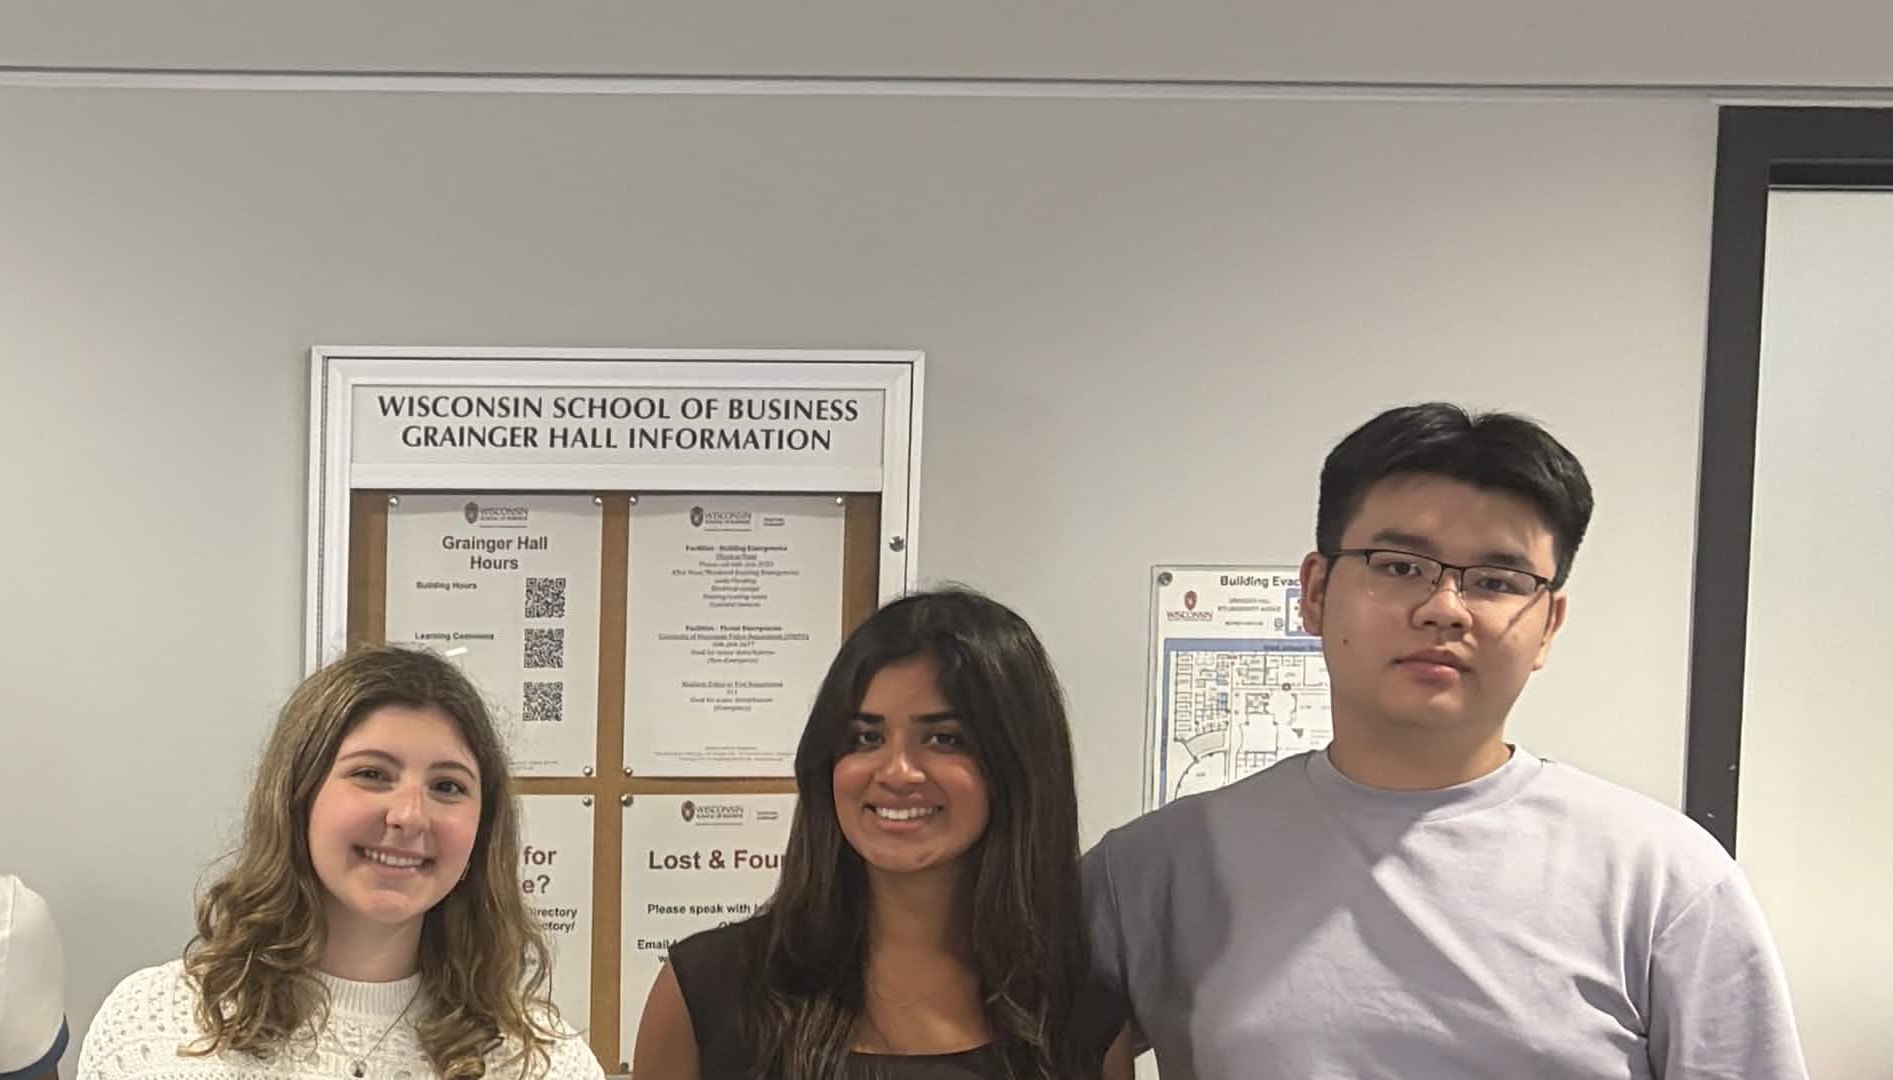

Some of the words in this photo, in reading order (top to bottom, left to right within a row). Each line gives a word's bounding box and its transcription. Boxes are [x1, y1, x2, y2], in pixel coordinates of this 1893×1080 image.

[377, 395, 544, 419] WISCONSIN
[553, 396, 671, 420] SCHOOL
[680, 397, 720, 420] OF
[728, 398, 859, 422] BUSINESS
[401, 425, 539, 449] GRAINGER
[549, 427, 618, 449] HALL
[629, 427, 832, 451] INFORMATION
[442, 535, 513, 553] Grainger
[517, 535, 548, 551] Hall
[470, 555, 519, 570] Hours
[416, 581, 450, 591] Building
[452, 581, 478, 590] Hours
[1219, 575, 1269, 589] Building
[414, 632, 451, 642] Learning
[523, 846, 557, 865] for
[648, 850, 701, 870] Lost
[708, 849, 726, 870] &
[647, 903, 686, 915] Please
[689, 903, 724, 916] speak
[726, 903, 751, 914] with
